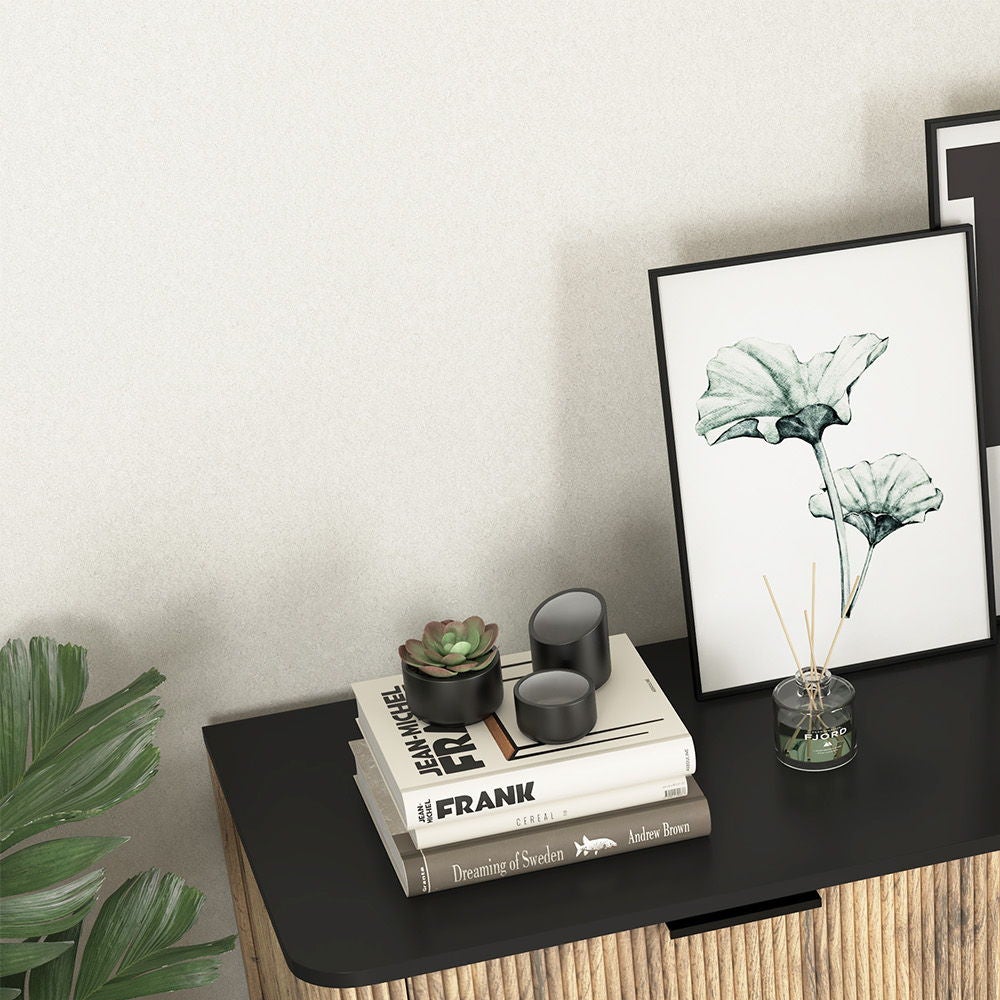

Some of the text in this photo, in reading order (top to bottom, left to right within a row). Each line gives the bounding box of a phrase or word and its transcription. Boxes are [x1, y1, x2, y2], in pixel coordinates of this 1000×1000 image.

[381, 684, 443, 777] JEAN-MICHEL
[804, 727, 847, 741] FJORD
[425, 799, 434, 824] MICHEL
[435, 781, 536, 820] FRANK
[417, 803, 425, 823] JEAN-
[516, 812, 555, 827] CEREAL
[628, 822, 691, 845] Andrew Brown
[452, 846, 564, 883] Dreaming of Sweden
